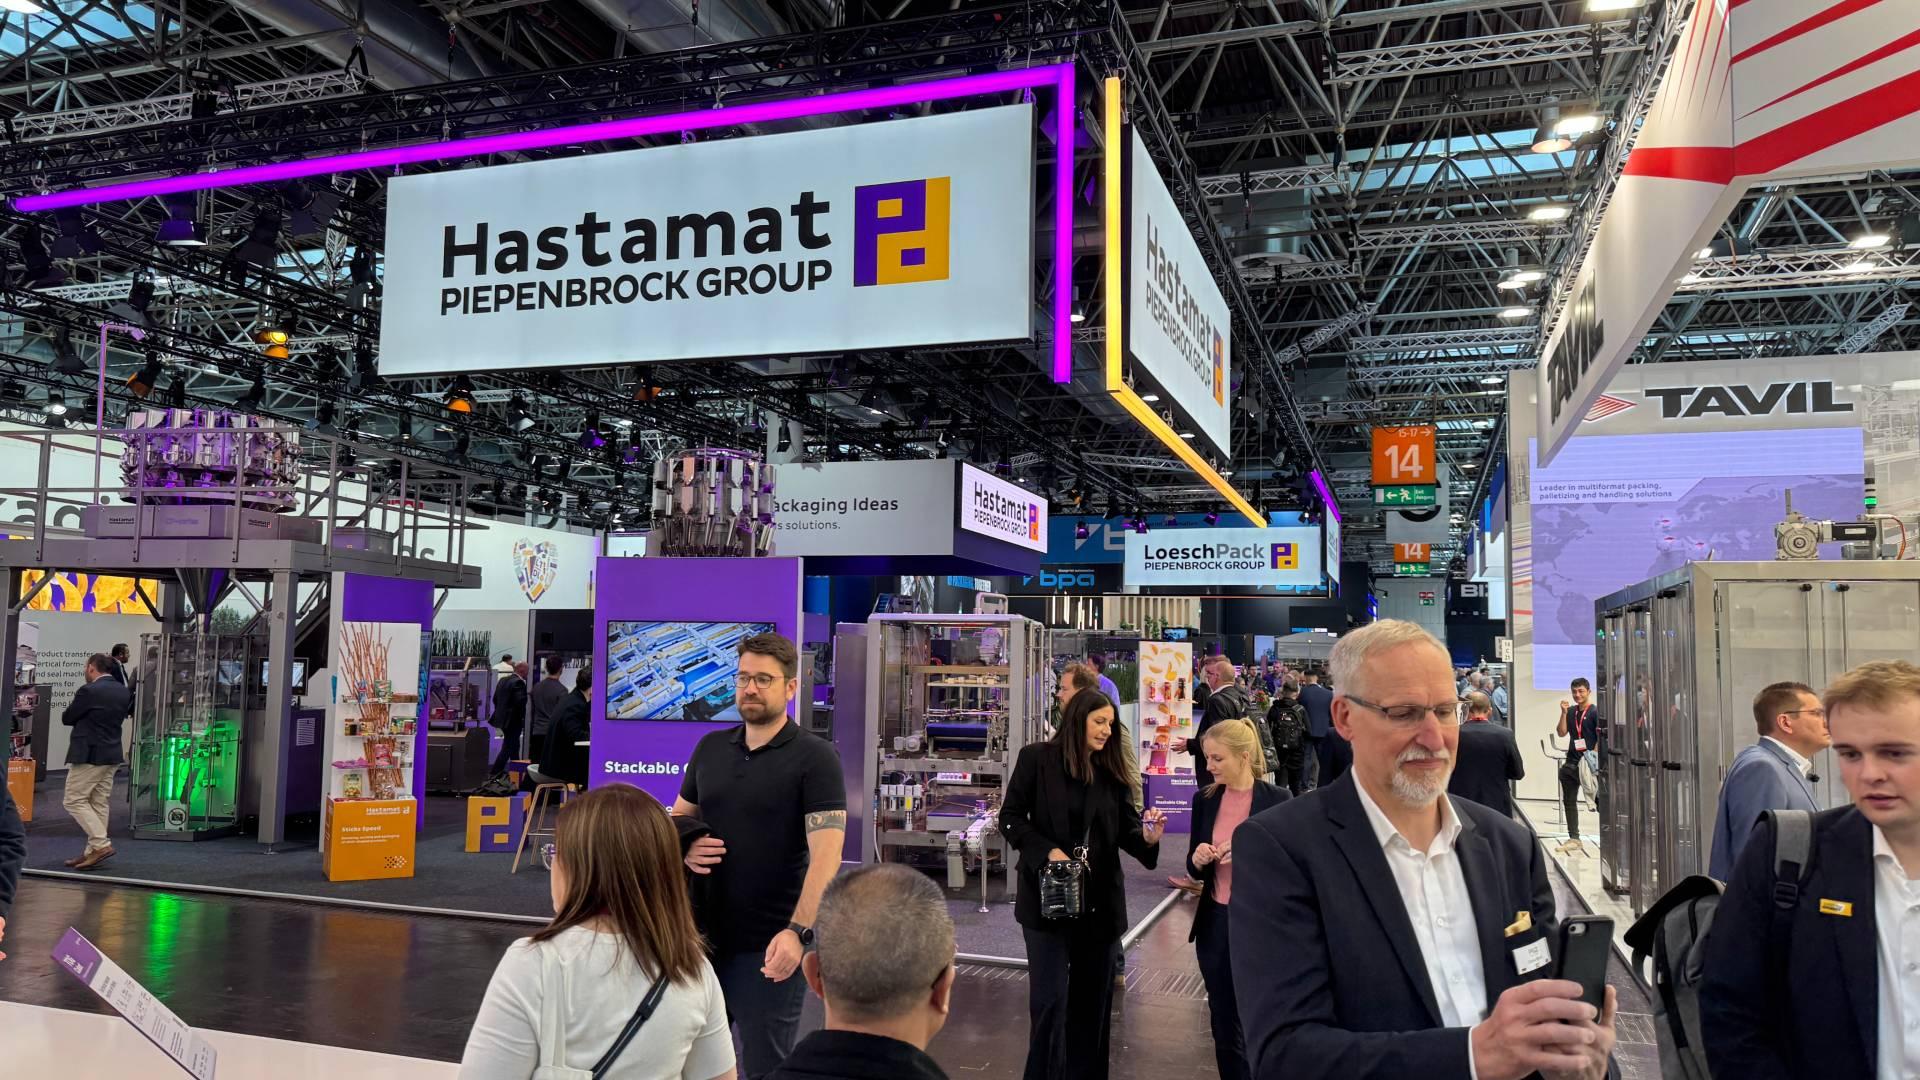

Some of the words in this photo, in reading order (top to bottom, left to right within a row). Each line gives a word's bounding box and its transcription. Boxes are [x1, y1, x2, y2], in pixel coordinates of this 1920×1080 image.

[442, 191, 832, 278] Hastamat
[441, 268, 690, 316] PIEPENBROCK
[696, 259, 832, 298] GROUP
[1146, 212, 1211, 361] Hastamat
[1146, 280, 1194, 371] PIEPENBROCK
[1193, 352, 1211, 390] GROUP
[1548, 269, 1605, 427] TAVIL
[1644, 381, 1854, 419] TAVIL
[1399, 428, 1418, 438] 15-17
[1384, 444, 1424, 479] 14
[1539, 484, 1566, 492] Leader
[1578, 483, 1625, 491] multiformat
[1627, 482, 1662, 491] packing,
[1539, 492, 1580, 500] palletizing
[1582, 491, 1597, 499] and
[1599, 491, 1634, 500] handling
[853, 497, 899, 511] Ideas
[974, 481, 1027, 523] Hastamat
[785, 520, 841, 530] solutions.
[974, 508, 1011, 532] PIEPENBROCK
[1011, 521, 1027, 537] GROUP
[1145, 543, 1265, 560] LoeschPack
[1401, 543, 1424, 560] 14
[1145, 561, 1223, 571] PIEPENBROCK
[1225, 561, 1265, 570] GROUP
[1040, 569, 1095, 590] bpa
[605, 761, 680, 775] Stackable
